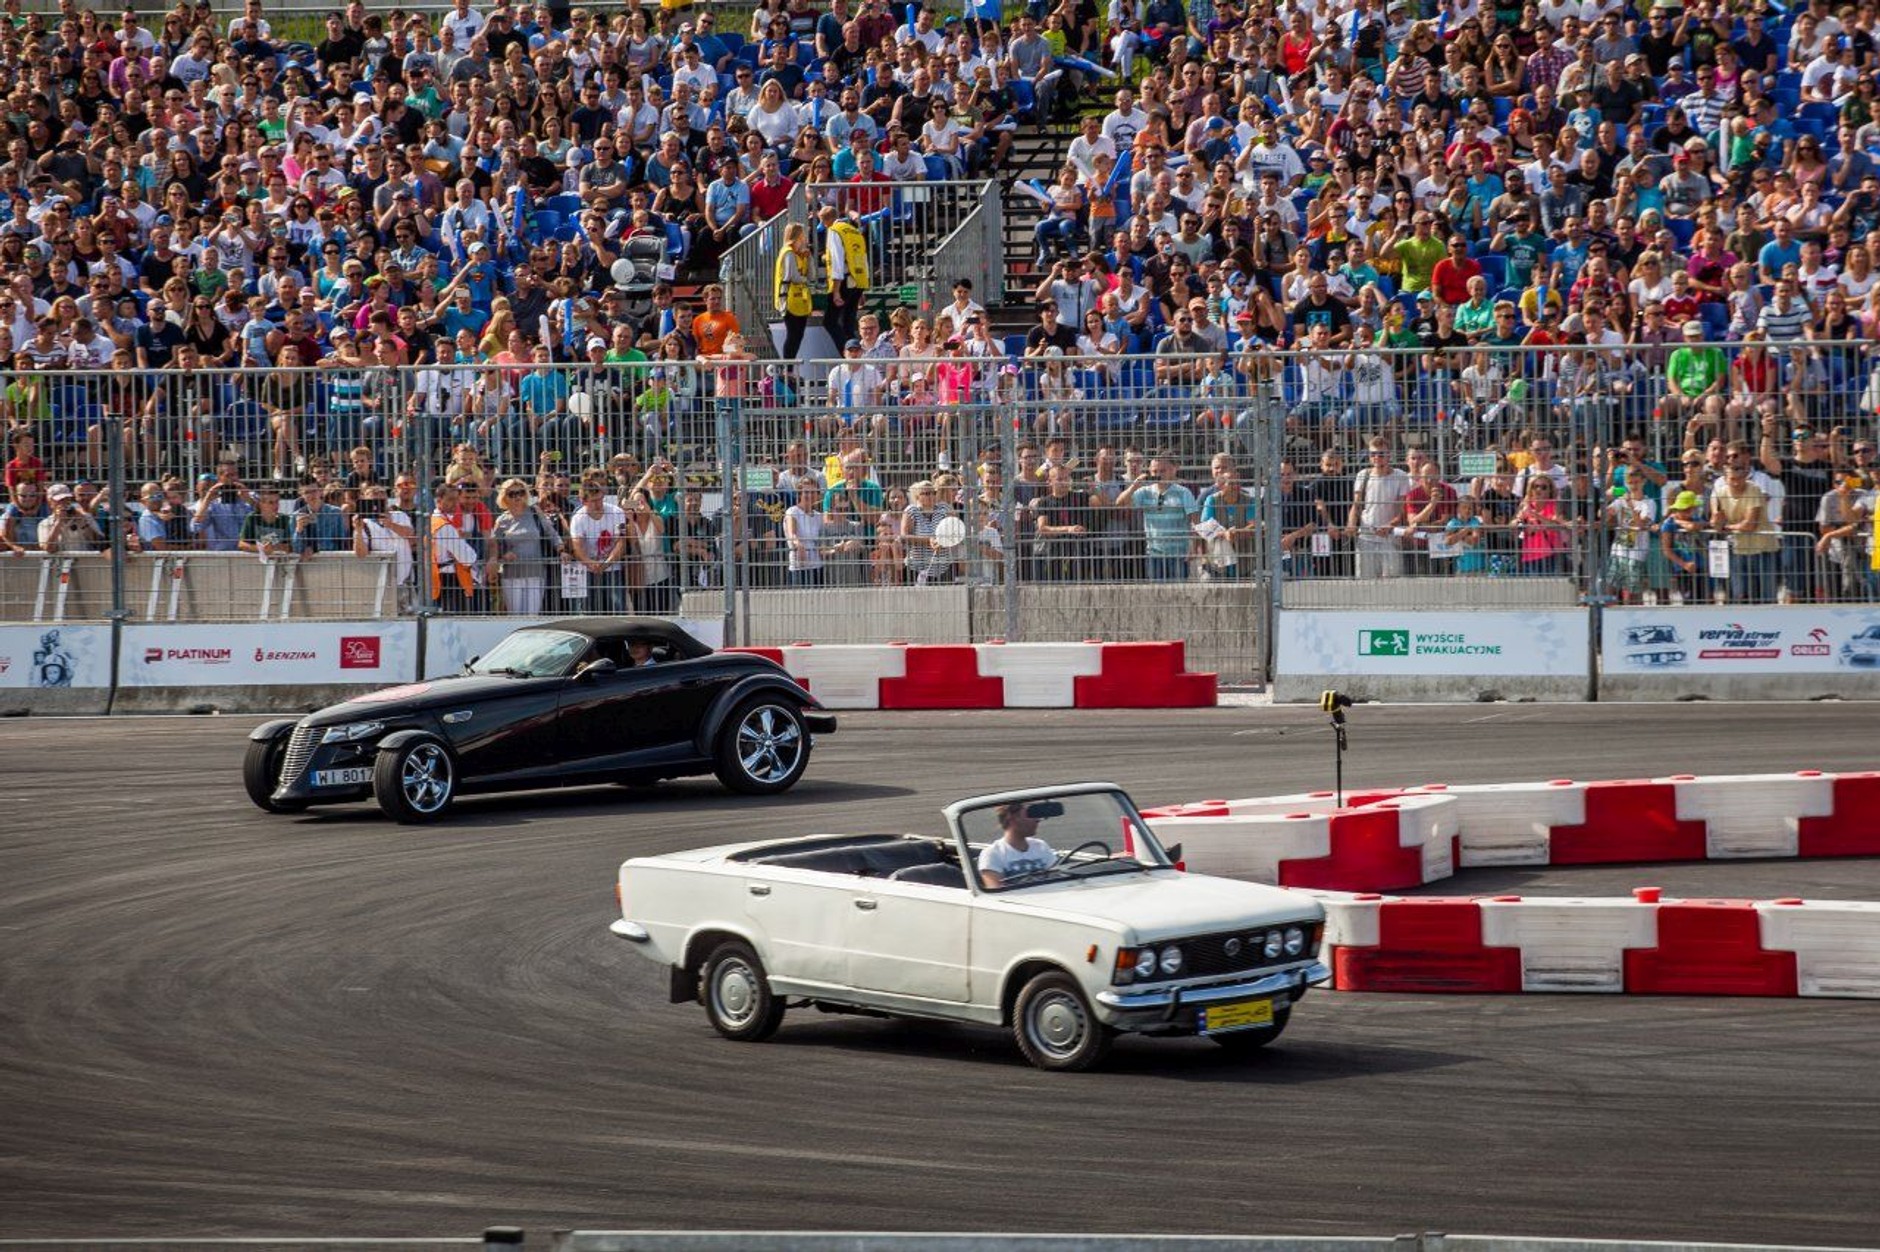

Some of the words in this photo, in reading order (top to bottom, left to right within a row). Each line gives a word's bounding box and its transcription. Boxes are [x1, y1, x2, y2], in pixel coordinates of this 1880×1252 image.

[1416, 632, 1465, 643] WYJŚCIE
[167, 649, 231, 659] PLATINUM
[1416, 645, 1502, 655] EWAKUACYJNE
[1793, 646, 1828, 655] ORLEN
[266, 651, 316, 660] BENZINA
